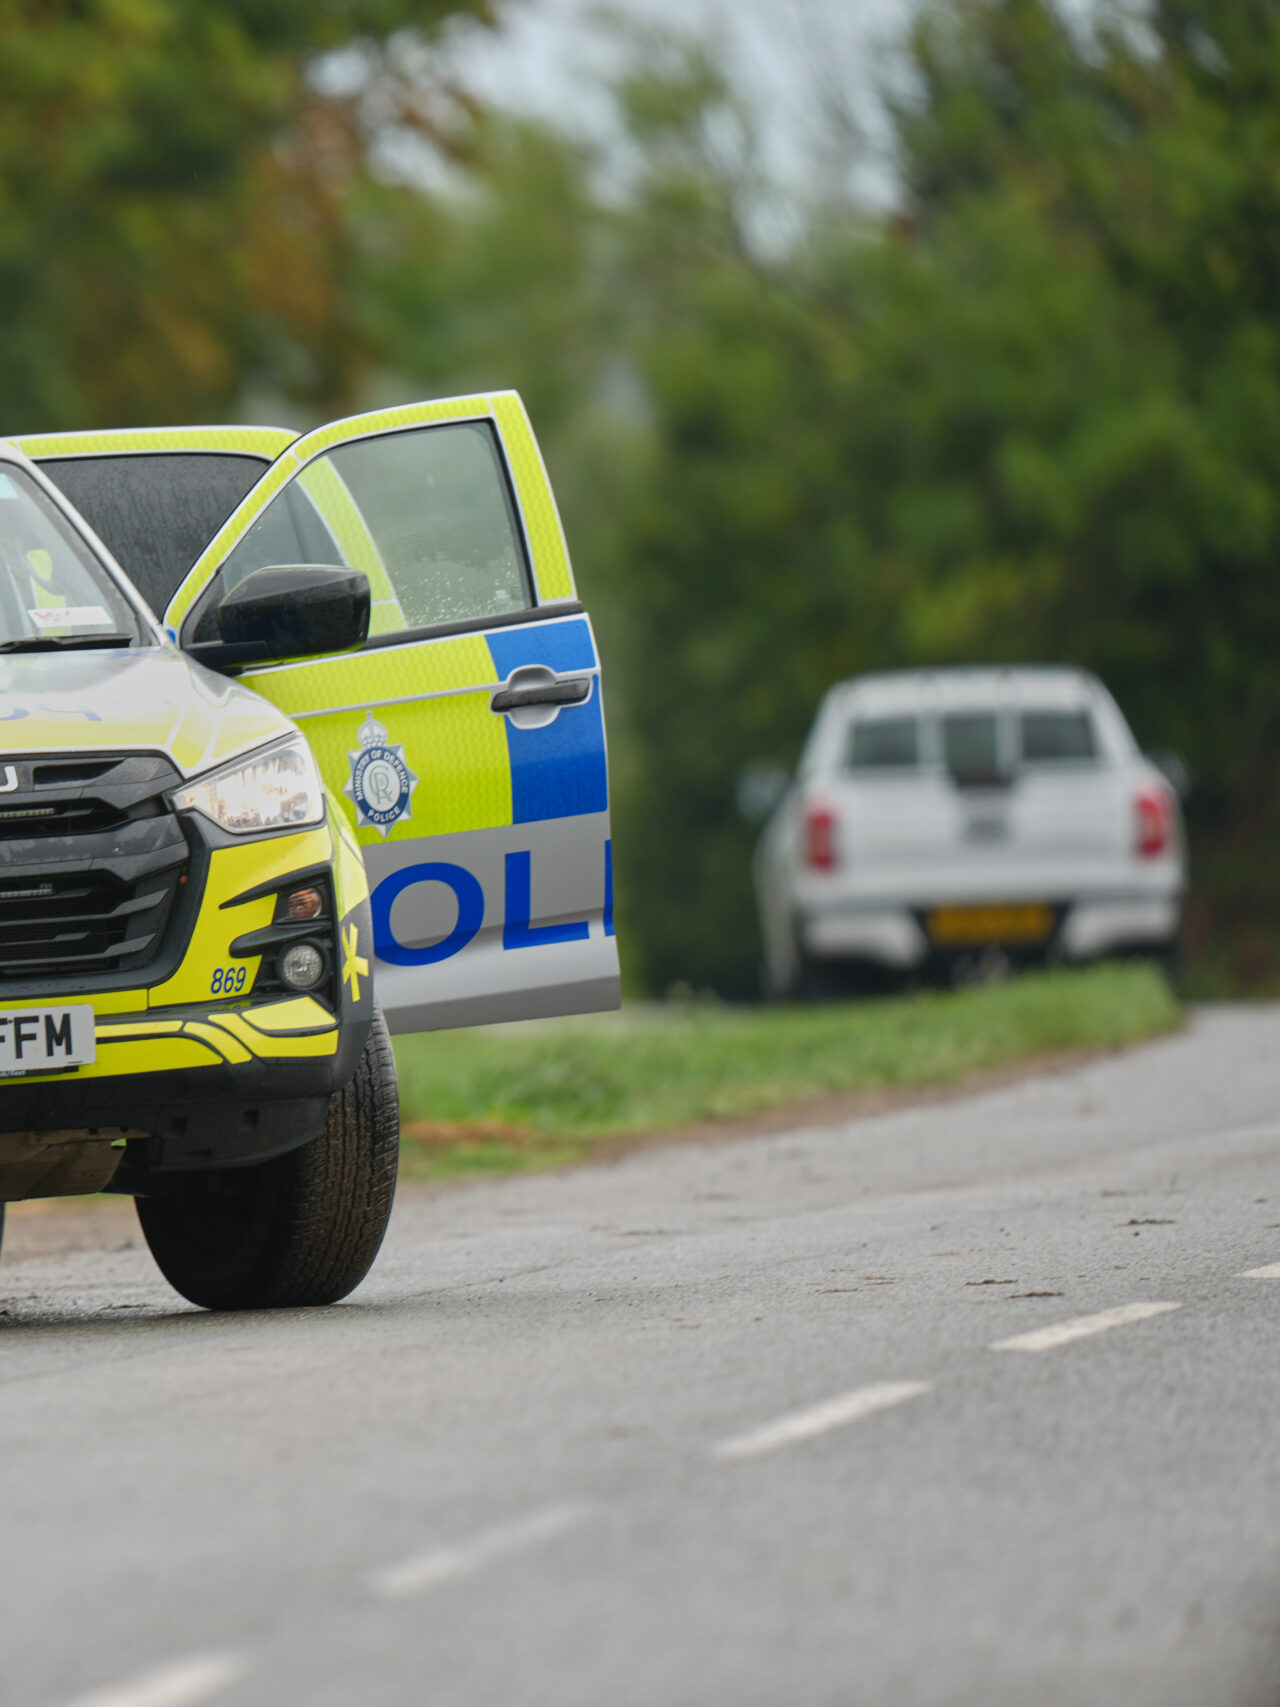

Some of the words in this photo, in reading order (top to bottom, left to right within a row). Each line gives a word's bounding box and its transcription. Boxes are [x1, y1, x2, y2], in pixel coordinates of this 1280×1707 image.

[354, 753, 371, 801] MINISTRY
[371, 750, 384, 760] OF
[383, 751, 409, 794] DEFENCE
[368, 805, 401, 822] POLICE
[210, 966, 246, 994] 869
